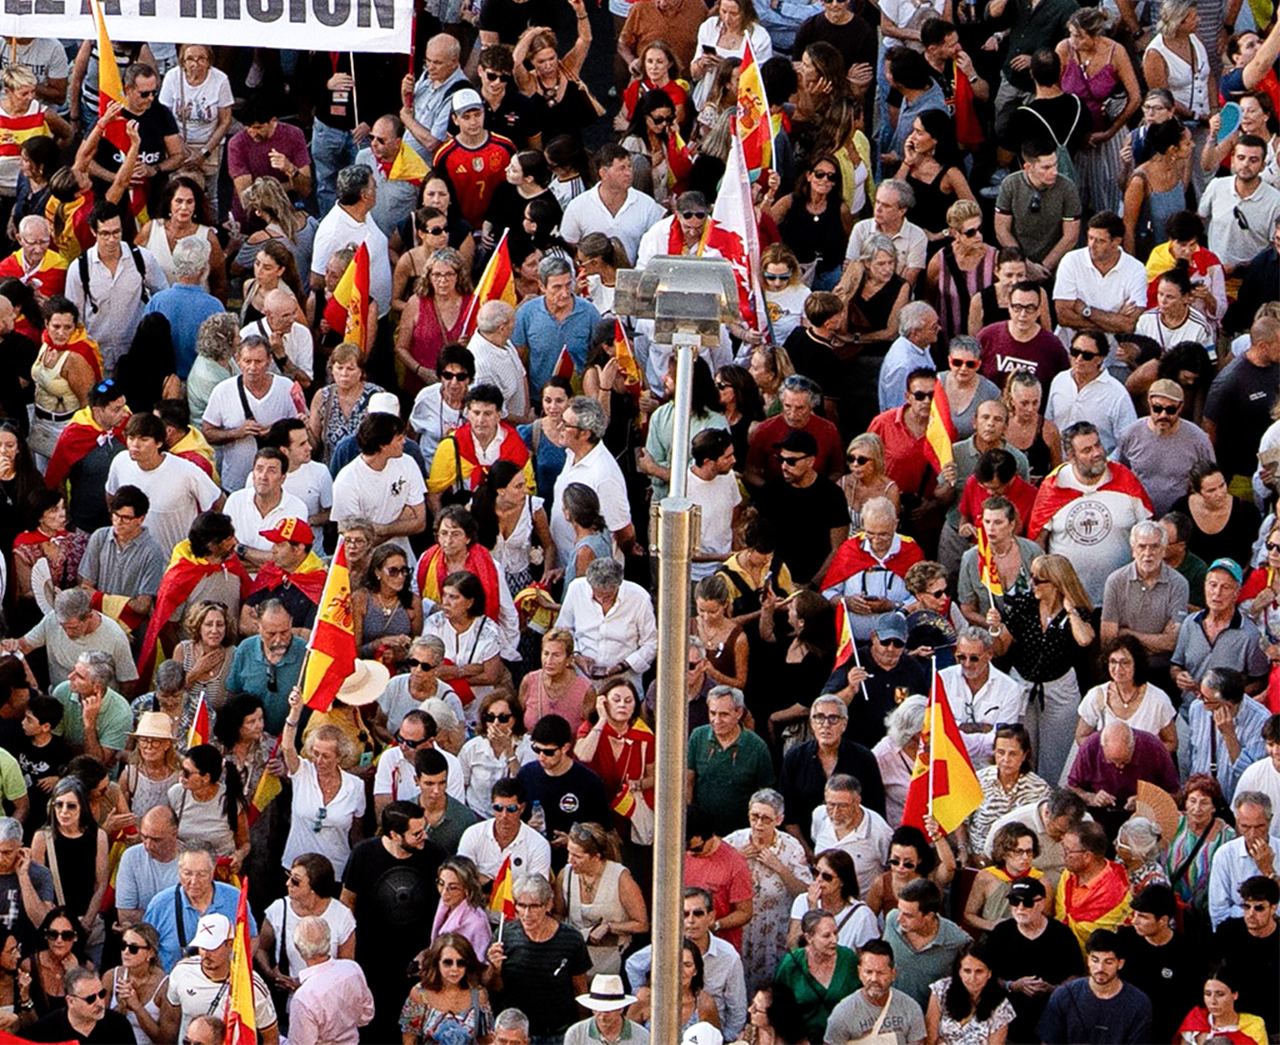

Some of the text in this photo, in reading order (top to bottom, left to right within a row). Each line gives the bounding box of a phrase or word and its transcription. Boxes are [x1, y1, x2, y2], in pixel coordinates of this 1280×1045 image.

[113, 150, 160, 165] adas
[476, 181, 486, 200] 7
[859, 1016, 905, 1030] HILGER
